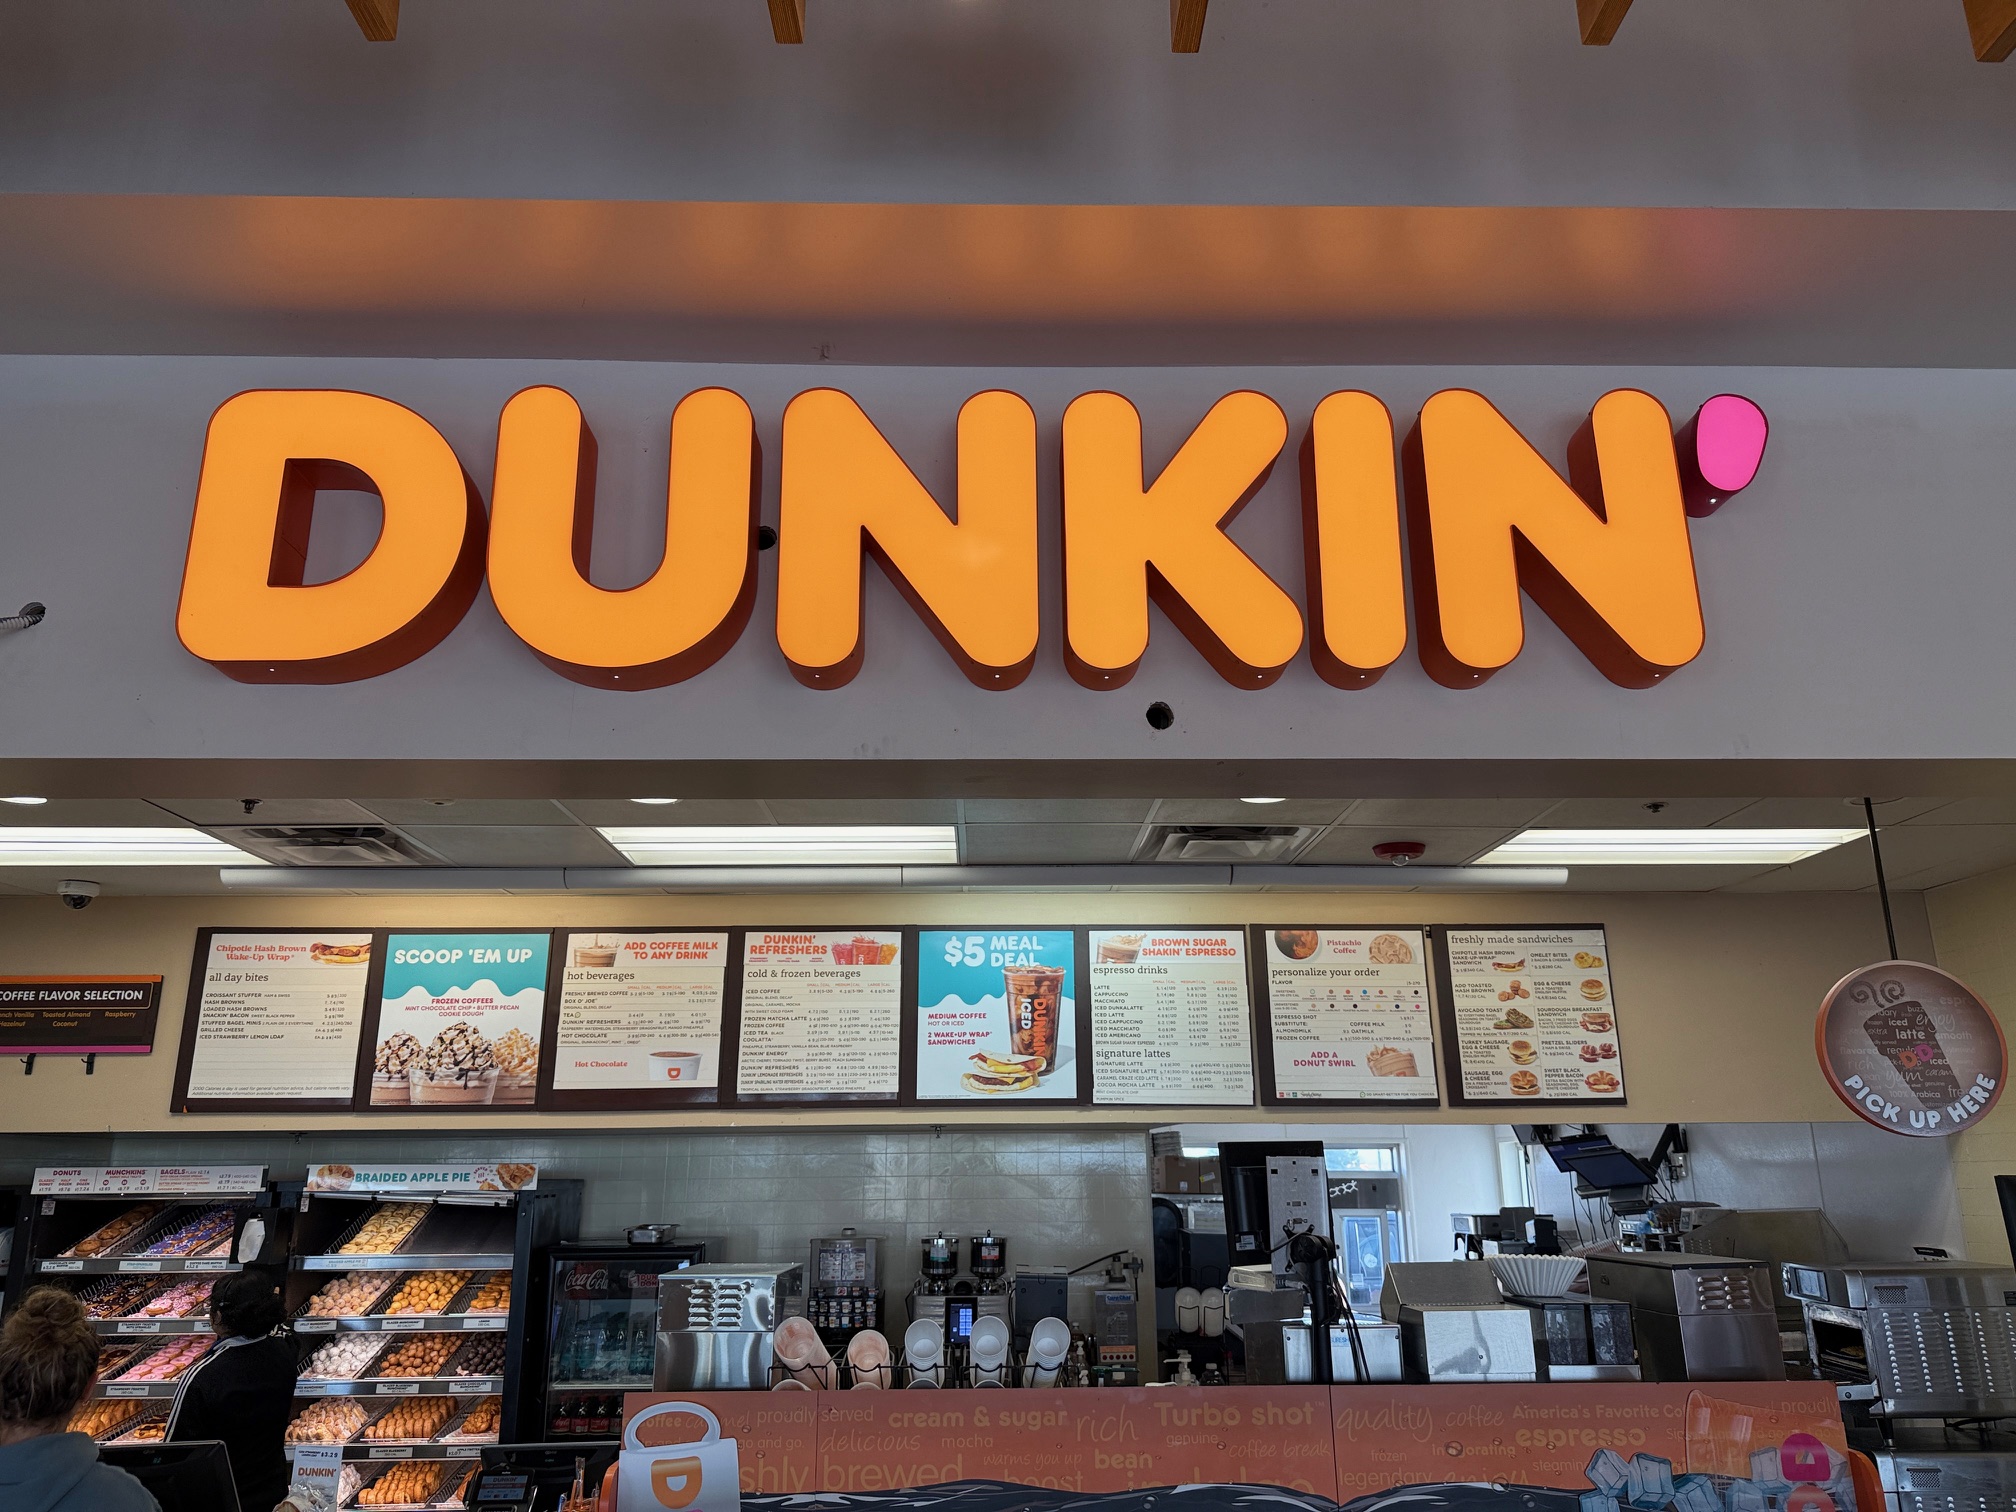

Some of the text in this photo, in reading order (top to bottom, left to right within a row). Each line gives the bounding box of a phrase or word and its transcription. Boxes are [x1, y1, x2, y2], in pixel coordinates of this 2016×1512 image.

[176, 385, 1769, 688] DUNKIN'
[624, 942, 718, 950] ADD COFFEE MILK
[764, 935, 816, 944] DUNKIN'
[990, 936, 1043, 950] MEAL
[1152, 939, 1190, 947] BROWN
[1451, 934, 1573, 945] freshly made sandwiches
[216, 945, 252, 953] Chipotle
[750, 946, 827, 954] REFRESHERS
[944, 936, 986, 967] $5
[1142, 948, 1236, 956] SHAKIN' ESPRESSO
[394, 949, 533, 964] SCOOP 'EM UP
[991, 953, 1041, 967] DEAL
[567, 972, 635, 982] hot beverages
[748, 970, 768, 978] cold
[781, 970, 811, 978] frozen
[814, 970, 861, 979] beverages
[1093, 966, 1168, 976] espresso drinks
[1272, 968, 1380, 978] personalize your order
[209, 973, 269, 984] all day bites
[39, 991, 80, 1001] FLAVOR
[84, 990, 143, 1000] SELECTION
[105, 1011, 136, 1019] Raspberry
[1021, 999, 1032, 1029] ICED
[1916, 1014, 1955, 1032] enjoy
[1896, 1029, 1926, 1040] latte
[1096, 1050, 1171, 1060] signature lattes
[1845, 1073, 1996, 1128] PICK UP HERE
[355, 1173, 407, 1182] BRAIDED
[410, 1173, 449, 1182] APPLE
[452, 1173, 470, 1182] PIE
[757, 1406, 874, 1426] proudly served
[888, 1406, 1067, 1431] cream & sugar
[1154, 1402, 1241, 1427] Turbo
[1513, 1404, 1660, 1419] America's Favorite
[1077, 1404, 1139, 1443] rich
[1336, 1400, 1505, 1442] quality coffee
[820, 1429, 993, 1452] delicious mocha
[1166, 1433, 1218, 1447] genuine
[1515, 1428, 1646, 1451] espresso
[1229, 1440, 1332, 1458] coffee break
[1371, 1450, 1407, 1462] frozen
[984, 1452, 1082, 1471] warms you up
[1095, 1450, 1153, 1469] bean
[298, 1468, 336, 1477] DUNKIN'
[823, 1454, 963, 1490] brewed
